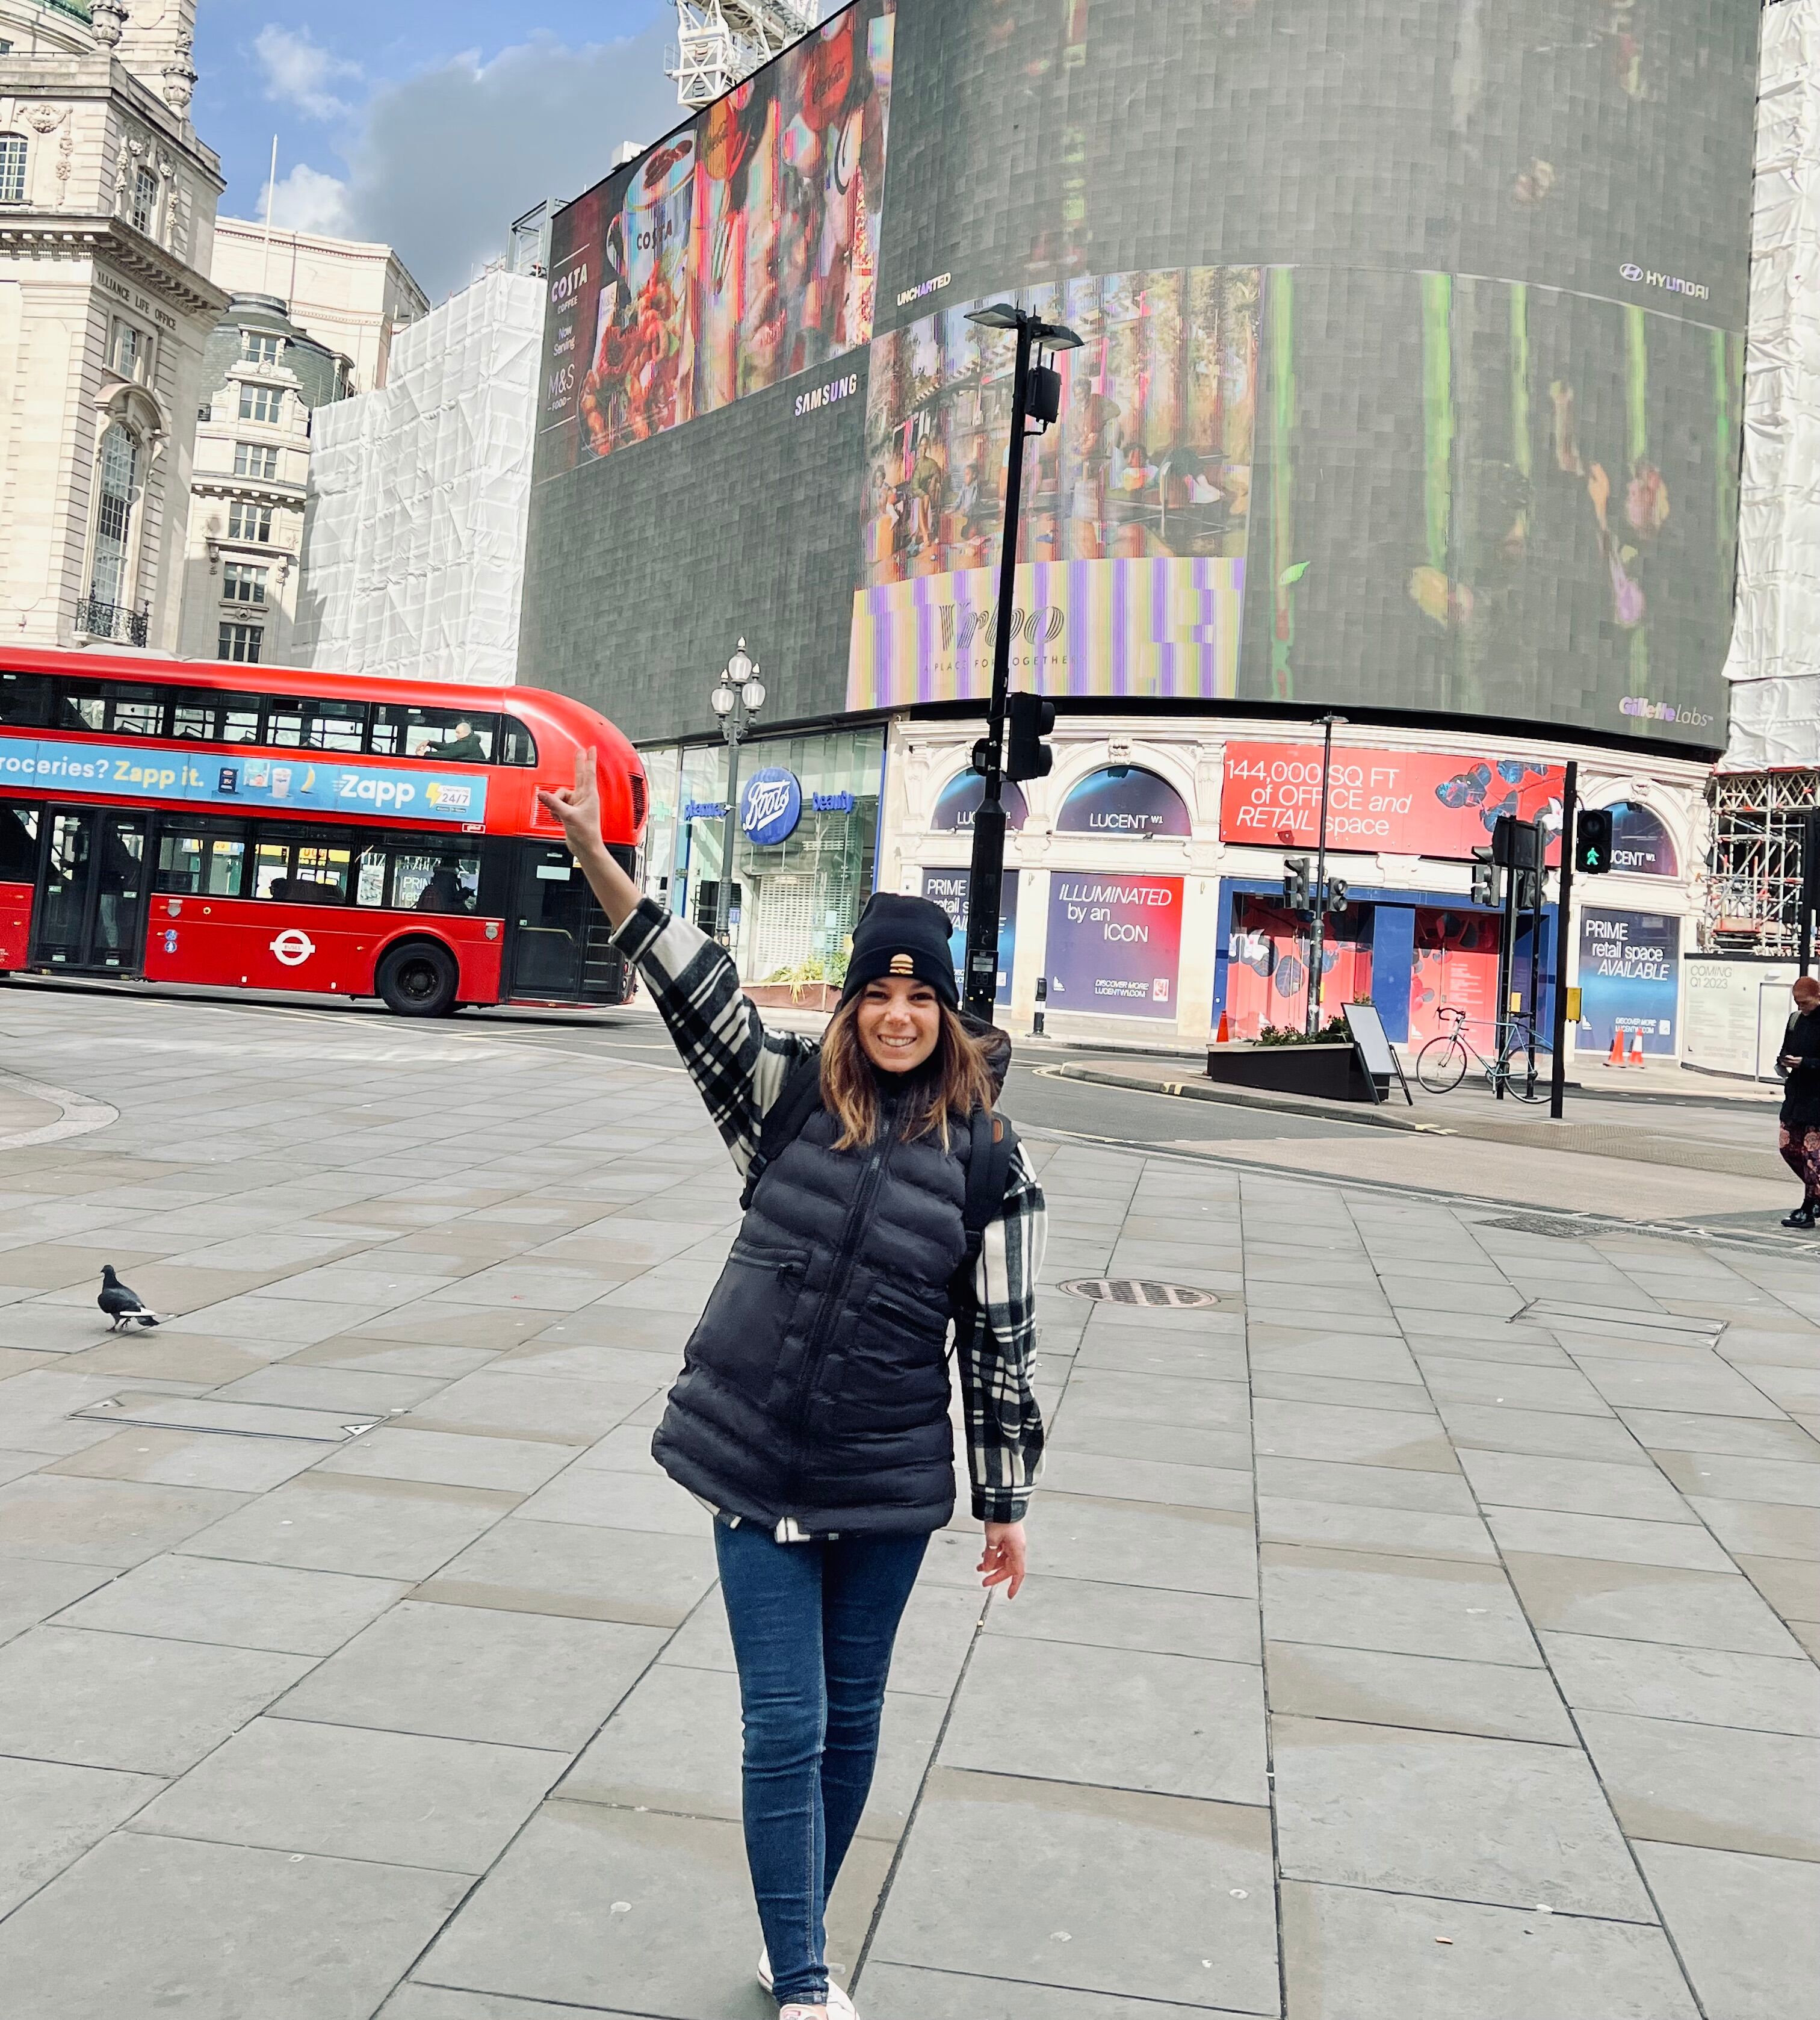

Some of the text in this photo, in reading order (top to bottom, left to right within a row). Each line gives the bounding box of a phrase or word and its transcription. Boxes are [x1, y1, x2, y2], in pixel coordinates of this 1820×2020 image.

[551, 263, 588, 303] COSTA
[896, 271, 951, 306] UNCHARTED
[1645, 270, 1709, 300] HYUNDAI
[135, 294, 149, 314] LIFE
[155, 308, 176, 330] OFFICE
[557, 294, 578, 315] COFFEE
[558, 324, 572, 341] Now
[553, 335, 576, 356] Serving
[547, 363, 575, 400] M&S
[794, 373, 858, 417] SAMSUNG
[113, 760, 176, 790] Zapp
[181, 765, 205, 787] it.
[1226, 759, 1400, 789] 144,000 SQ FT
[339, 774, 416, 809] Zapp
[442, 793, 469, 804] 24/7
[812, 790, 853, 814] beauty
[1251, 784, 1413, 814] of OFFCE and
[742, 779, 791, 831] Boots
[1089, 812, 1163, 829] LUCENT W1
[1236, 805, 1390, 836] RETAIL space
[927, 878, 968, 896] PRIME
[1059, 884, 1172, 906] ILLUMINATED
[1068, 903, 1110, 923] by an
[1104, 923, 1149, 943] ICON
[1585, 919, 1629, 940] PRIME
[1592, 941, 1664, 963] retail space
[1597, 958, 1671, 981] AVAILABLE
[1690, 965, 1732, 977] COMING
[1095, 979, 1150, 991] DISCOVER MORE
[1690, 977, 1729, 990] Q1 2023
